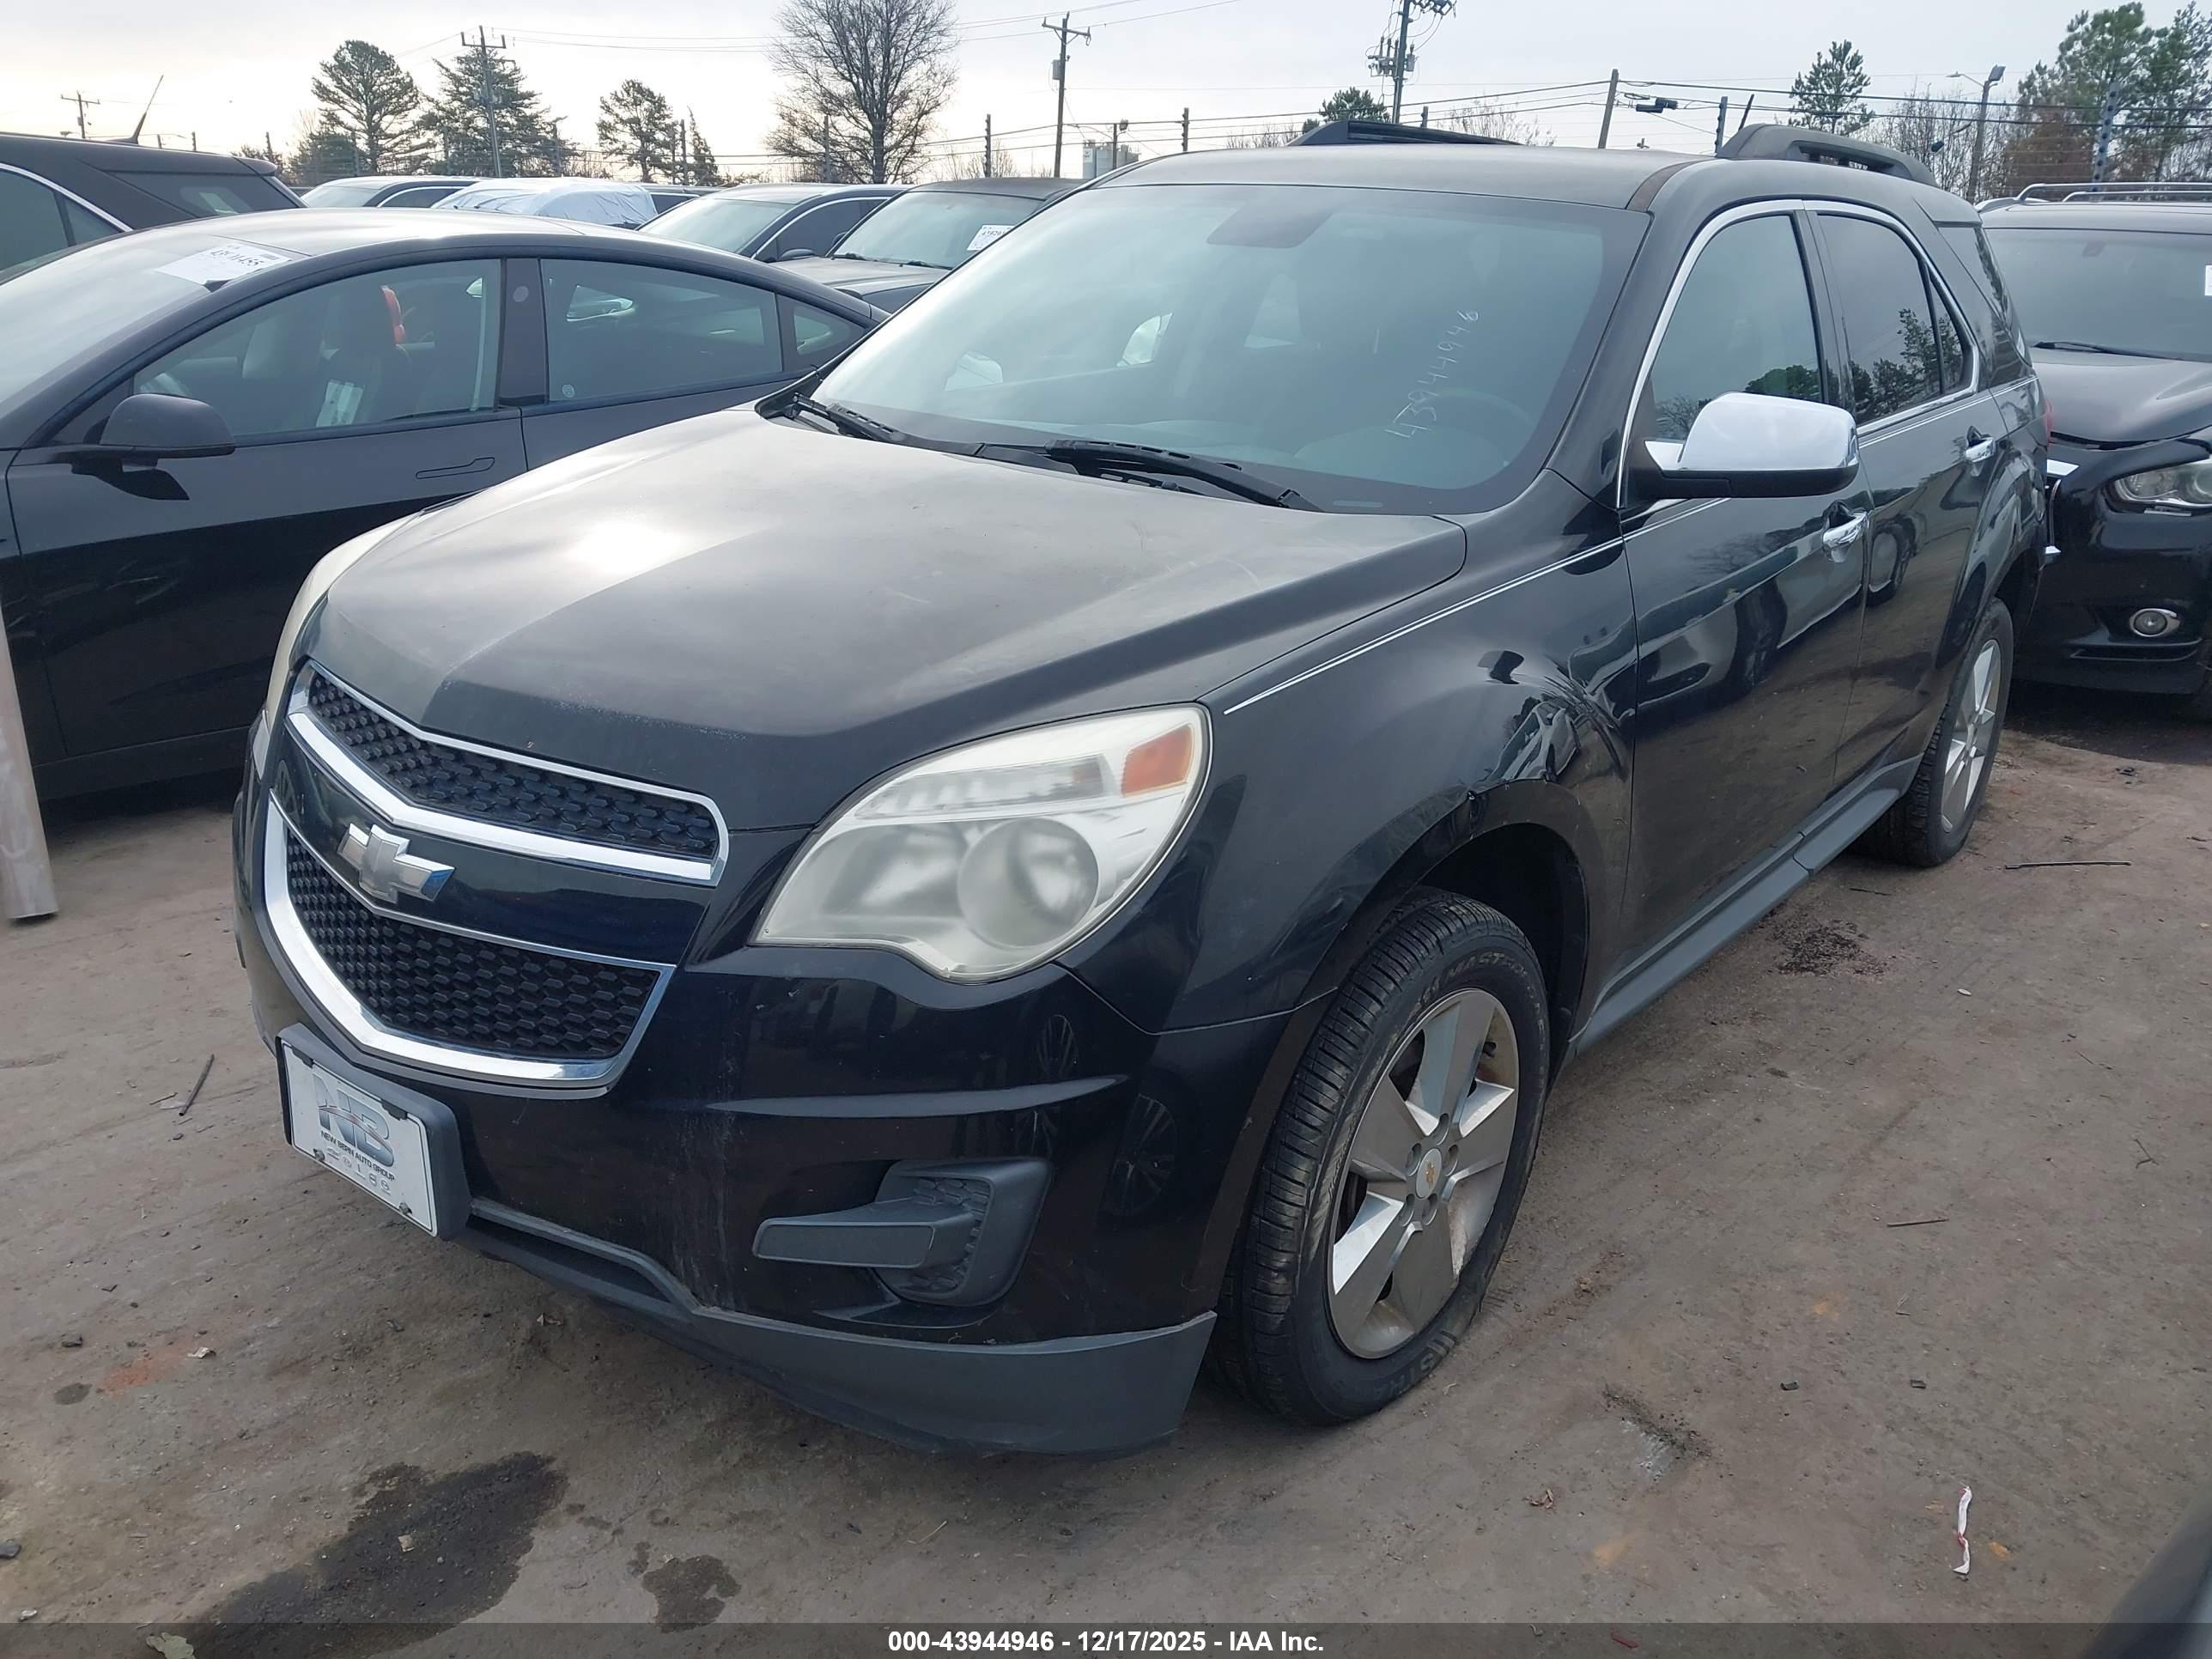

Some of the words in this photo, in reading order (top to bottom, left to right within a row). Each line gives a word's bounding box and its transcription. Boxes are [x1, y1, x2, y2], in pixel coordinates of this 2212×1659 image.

[320, 1130, 337, 1145] NEW
[337, 1140, 355, 1157] BERN
[355, 1152, 373, 1168] AUTO
[373, 1161, 395, 1182] GROUP
